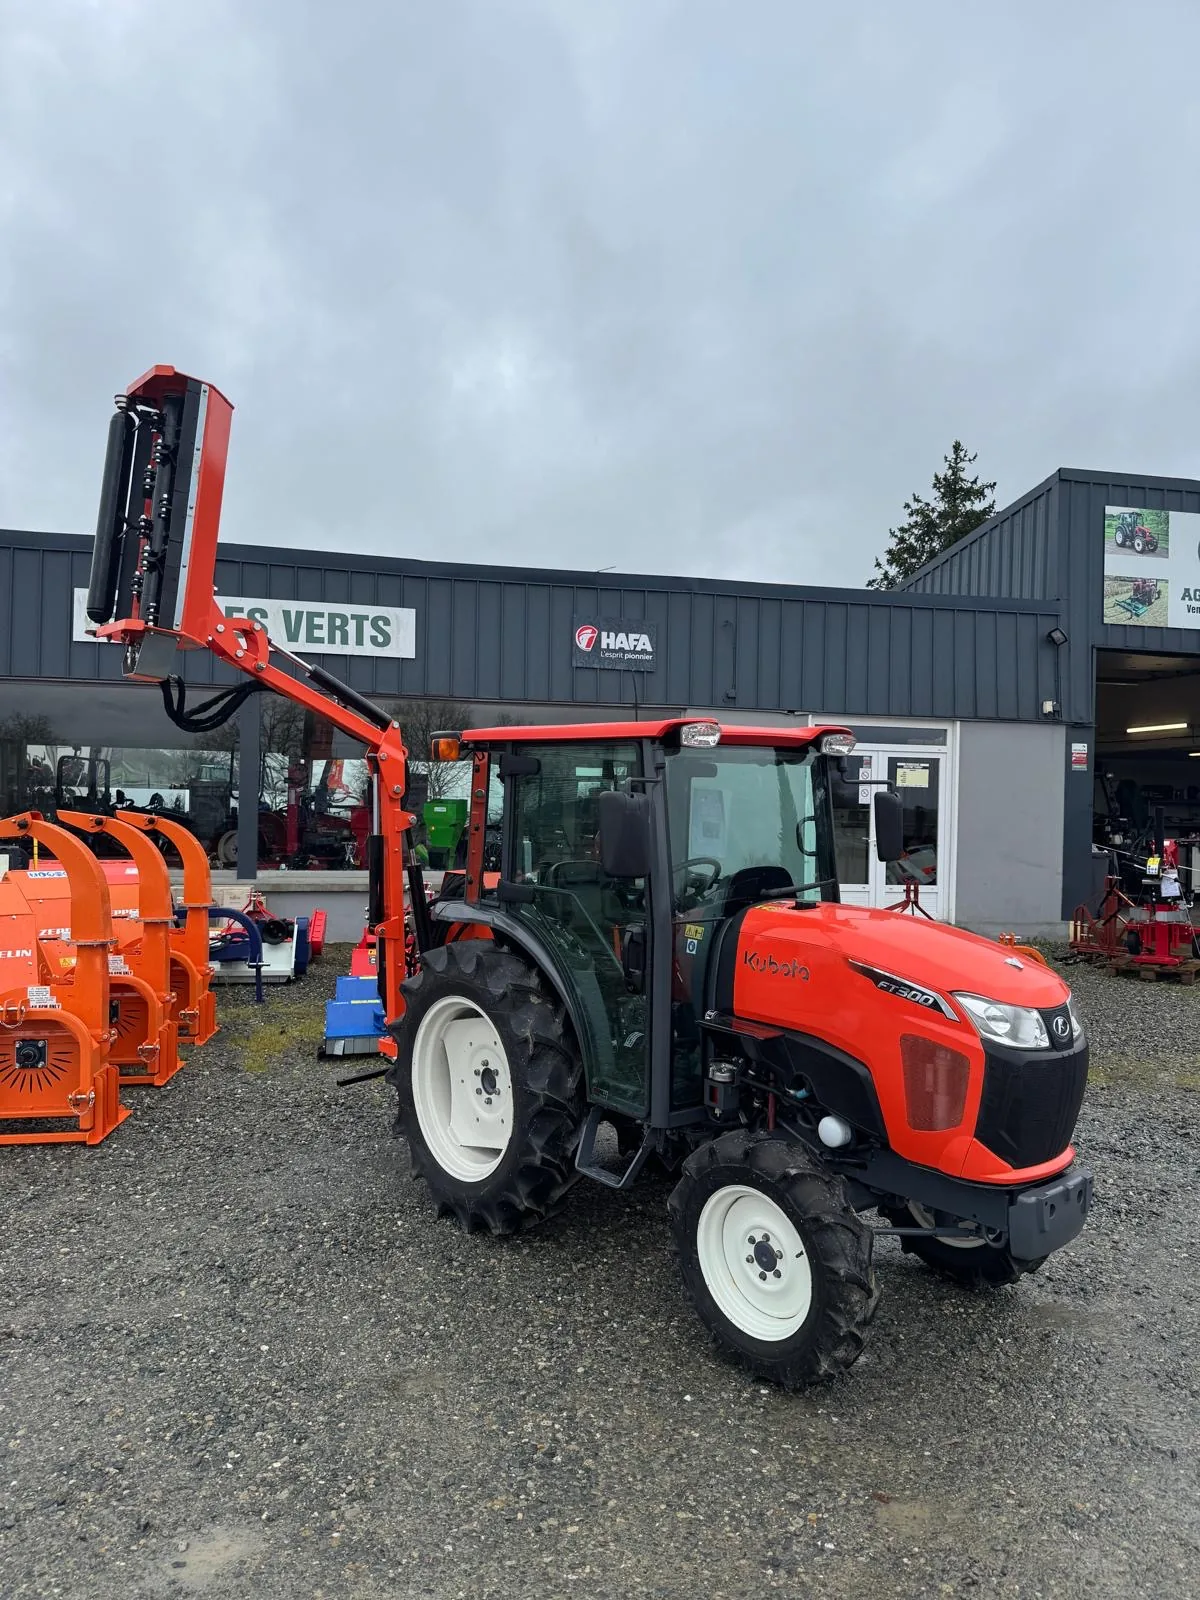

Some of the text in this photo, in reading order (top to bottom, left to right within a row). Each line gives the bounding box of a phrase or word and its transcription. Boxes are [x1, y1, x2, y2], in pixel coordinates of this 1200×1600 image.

[282, 609, 392, 648] VERTS
[601, 631, 653, 652] HAFA
[601, 651, 653, 661] L'esprit pionnier
[744, 950, 810, 982] Kubota
[877, 981, 935, 1006] FT300
